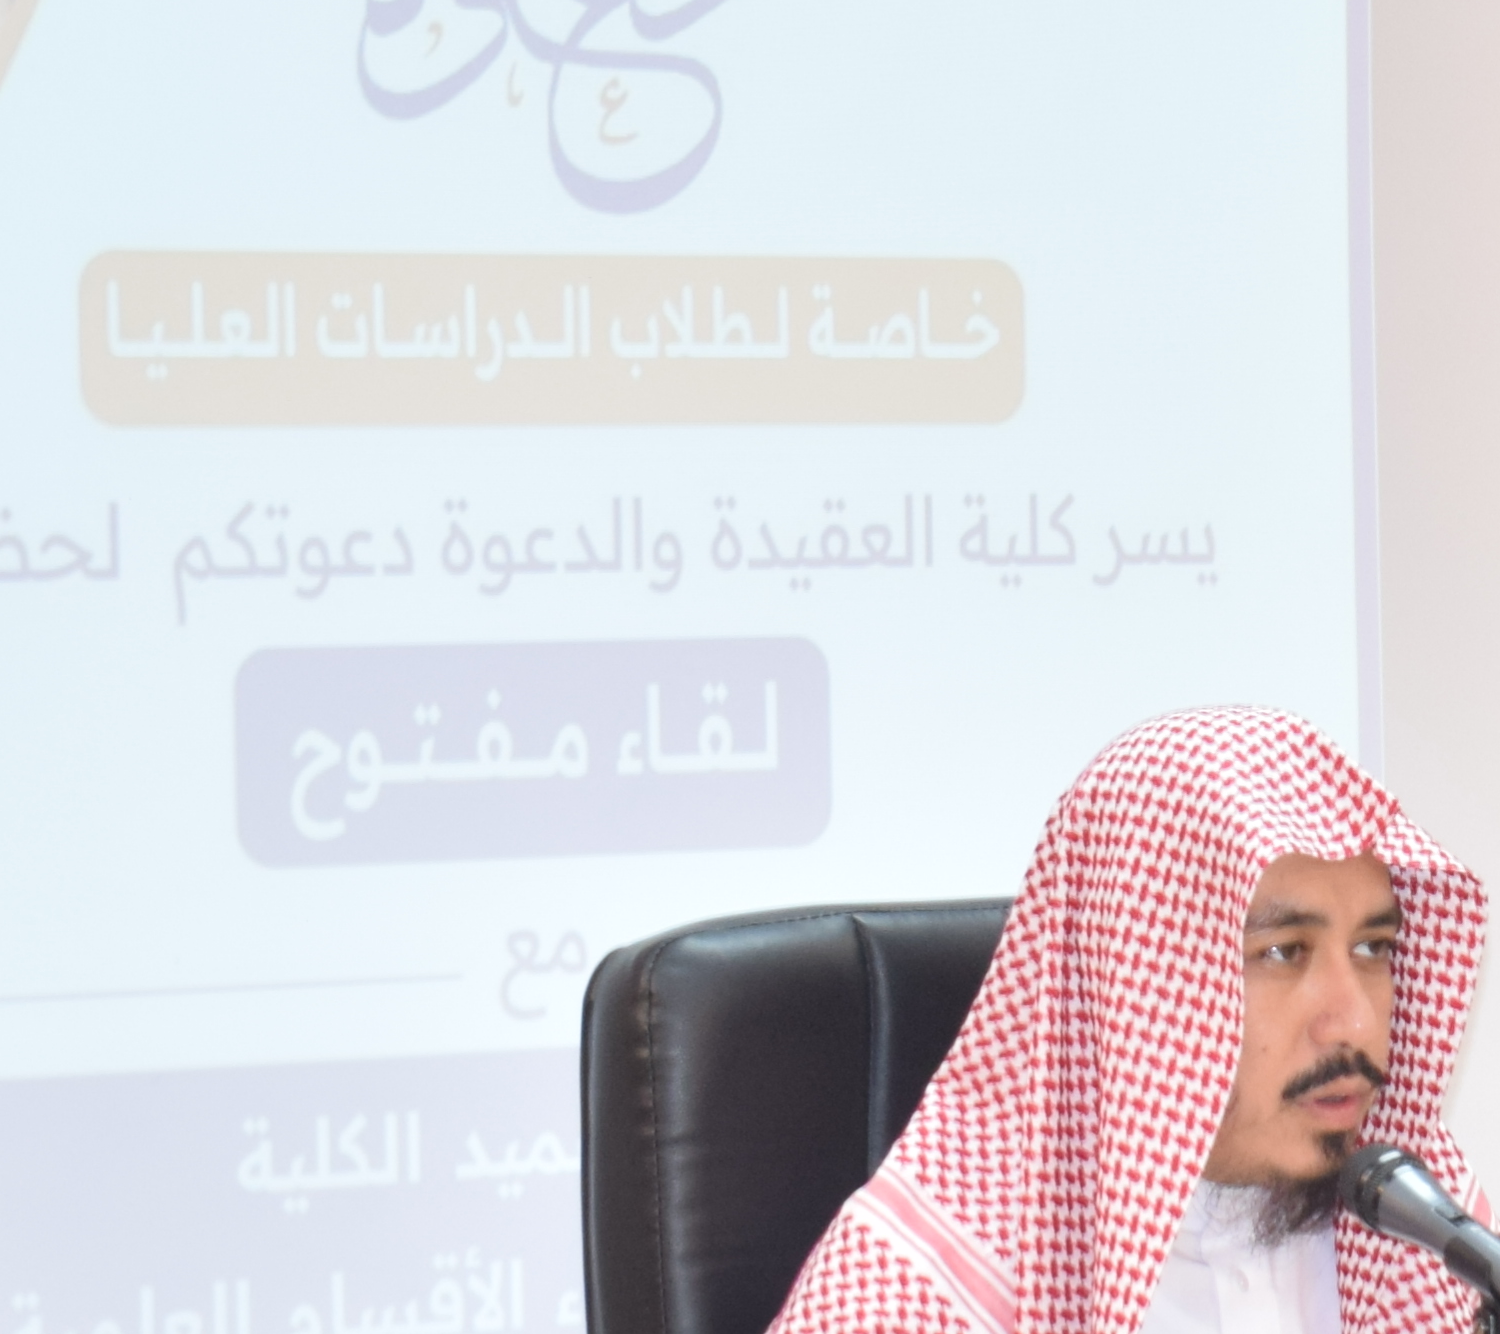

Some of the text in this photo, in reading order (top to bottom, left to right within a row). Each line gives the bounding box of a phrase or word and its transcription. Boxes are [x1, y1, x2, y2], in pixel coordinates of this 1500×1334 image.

[103, 280, 1004, 383] خاصة لطلاب الدراسات العليا
[173, 498, 415, 627] دعوتكم
[440, 494, 685, 597] والدعوة
[710, 492, 934, 592] العقيدة
[958, 491, 1077, 589] كلية
[1092, 520, 1219, 588] يسر
[289, 679, 779, 842] لقاء مفتوح
[499, 928, 589, 1021] مع
[237, 1109, 583, 1214] ميد الكلية
